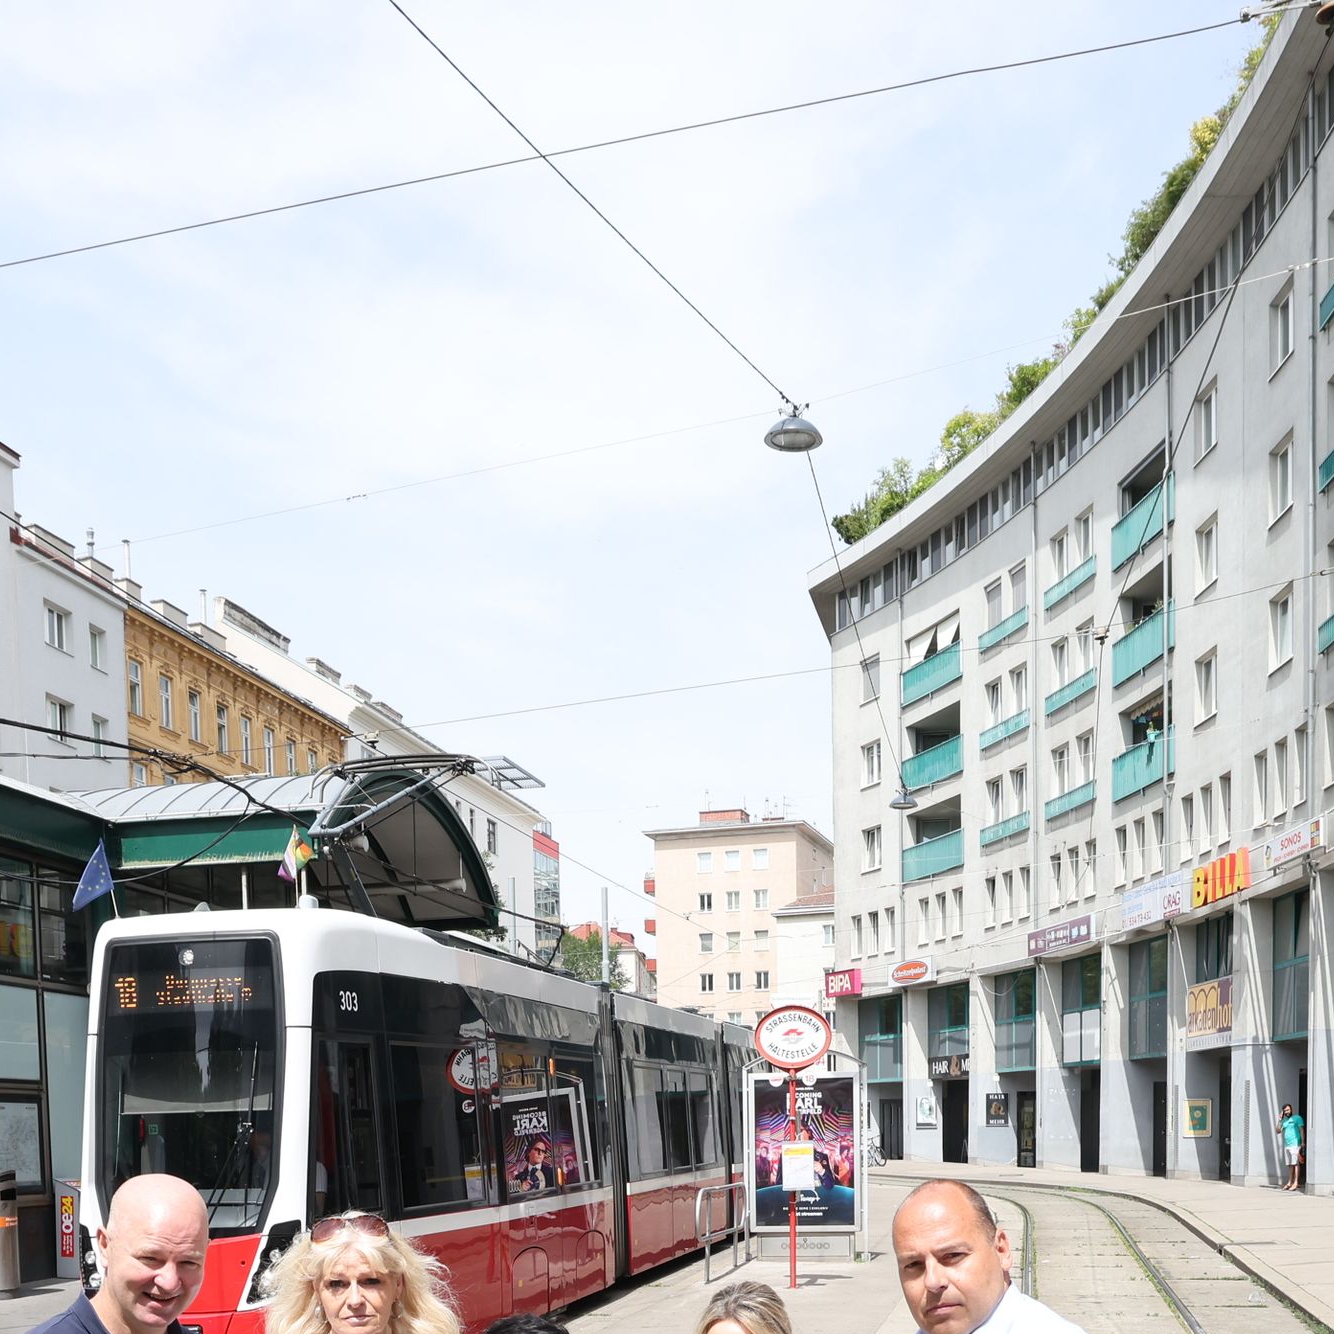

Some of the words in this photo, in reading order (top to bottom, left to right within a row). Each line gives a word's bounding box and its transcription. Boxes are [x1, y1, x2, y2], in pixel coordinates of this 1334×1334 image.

[1280, 831, 1302, 851] SONOS
[1193, 847, 1251, 909] BILLA
[115, 976, 137, 1008] 18
[828, 974, 851, 994] BIPA
[339, 990, 358, 1012] 303
[765, 1013, 821, 1033] STRASSENBAHN
[768, 1042, 819, 1059] HALTESTELLE
[932, 1060, 949, 1074] HAIR
[949, 1055, 961, 1077] &
[61, 1195, 73, 1234] oe24
